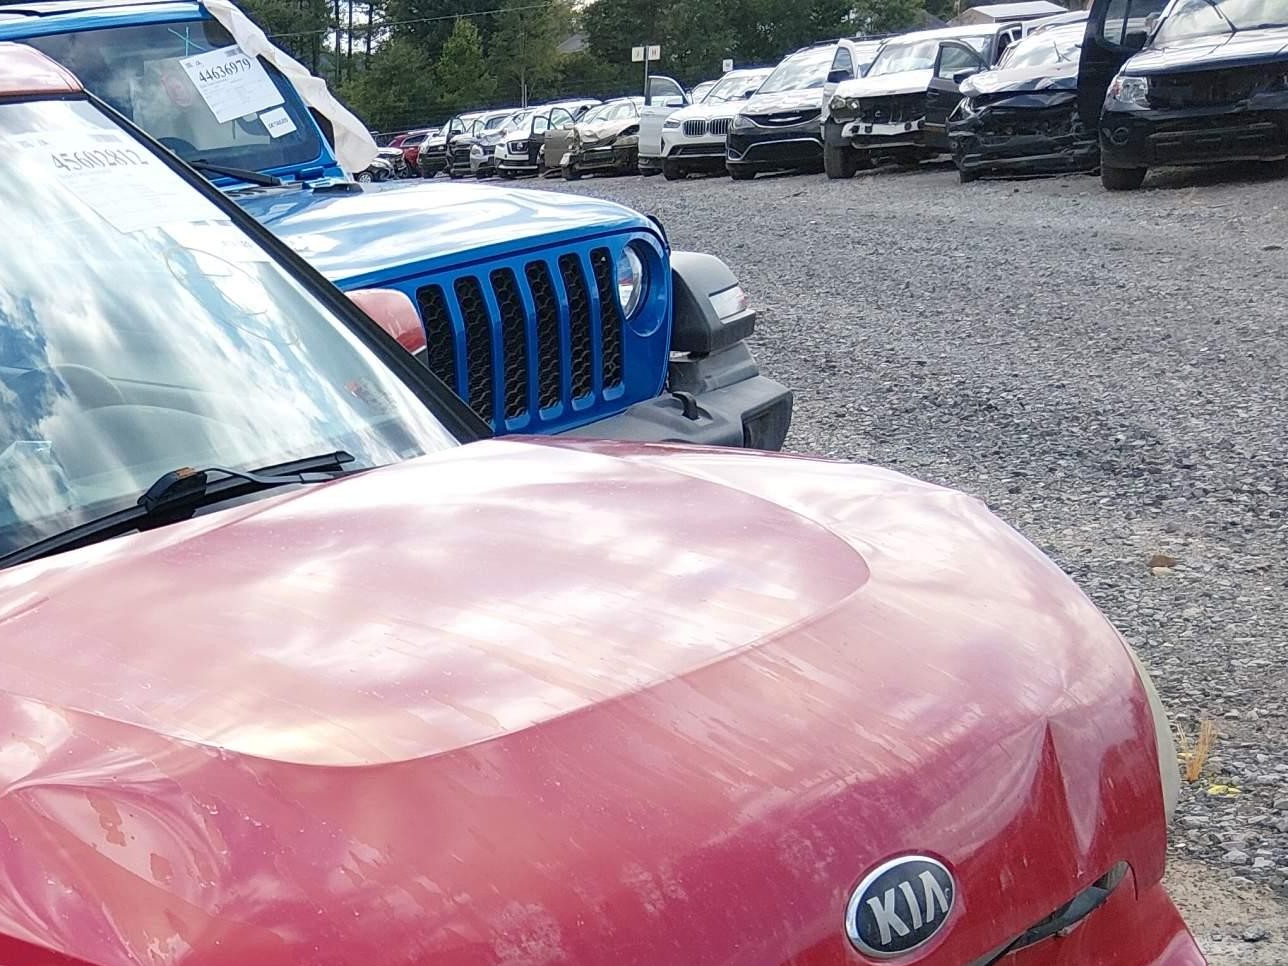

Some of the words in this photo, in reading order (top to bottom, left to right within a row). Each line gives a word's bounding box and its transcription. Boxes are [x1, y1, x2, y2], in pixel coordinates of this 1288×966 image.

[199, 58, 251, 83] 44636979
[51, 149, 148, 171] 45602812
[866, 870, 949, 945] KIA
